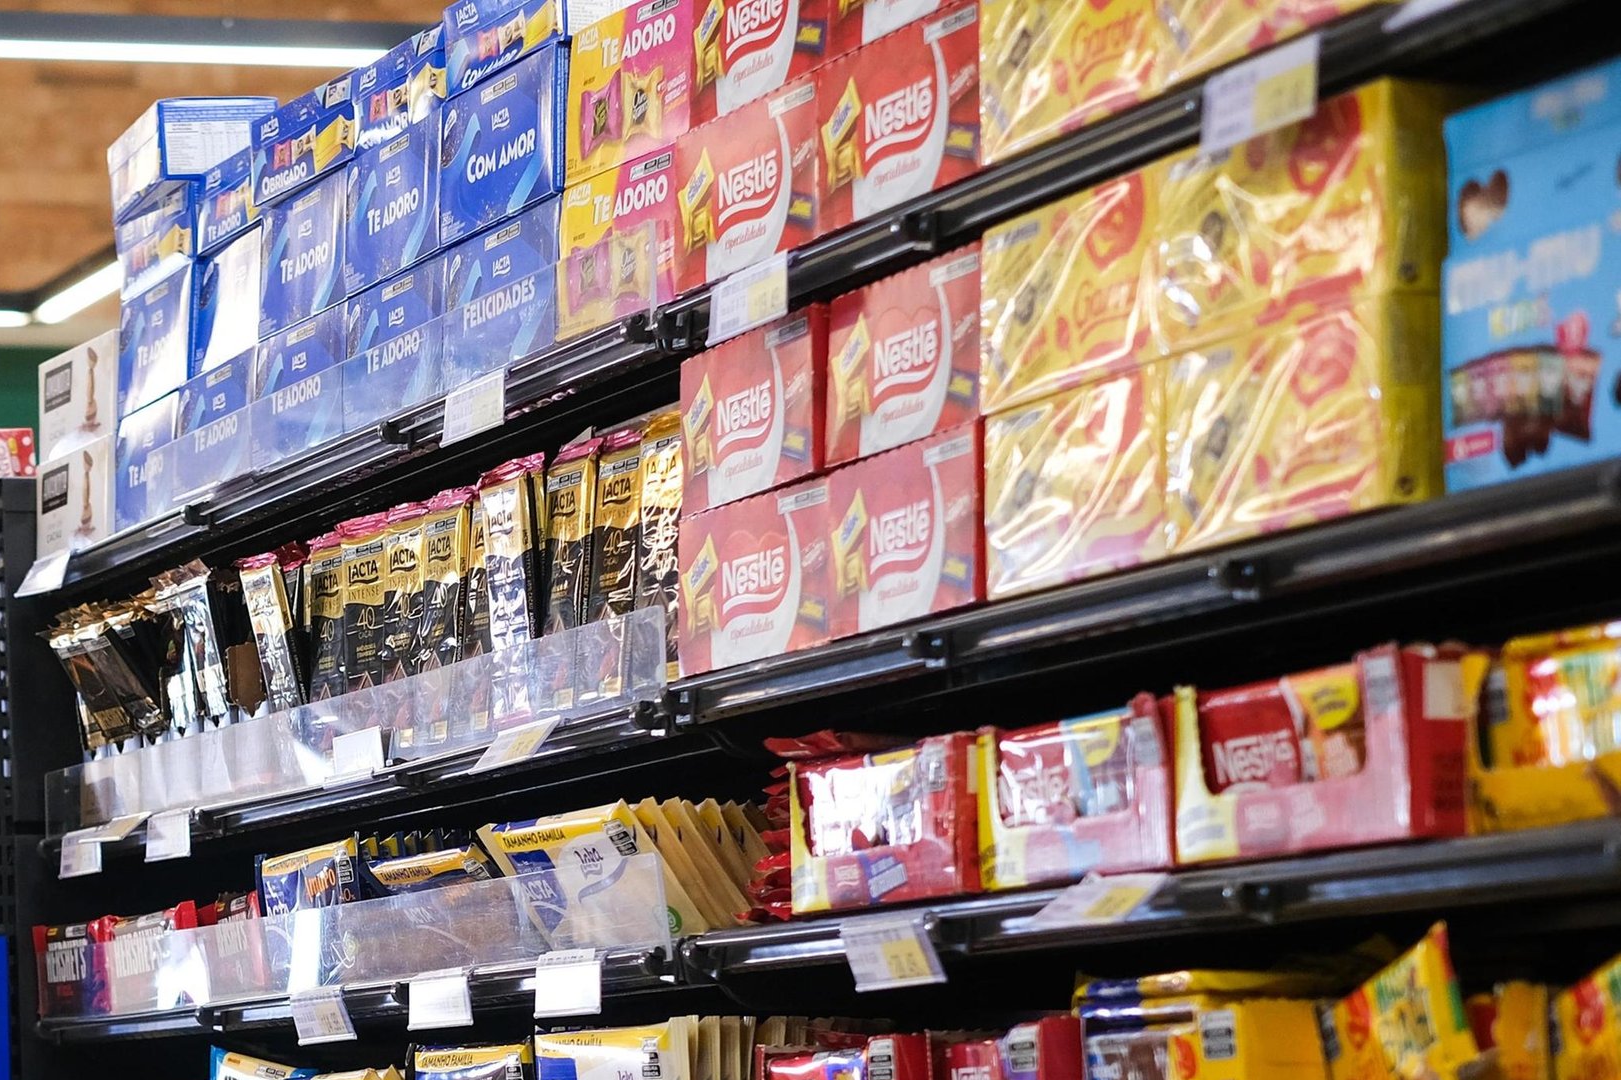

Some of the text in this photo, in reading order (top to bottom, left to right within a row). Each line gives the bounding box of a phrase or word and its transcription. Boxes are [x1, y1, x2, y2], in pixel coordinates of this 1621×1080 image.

[456, 2, 478, 27] LACTA
[578, 26, 598, 53] LACTA
[602, 14, 675, 68] TE ADORO
[360, 67, 376, 91] LACTA
[492, 107, 510, 131] LACTA
[865, 75, 932, 144] Nestlé
[261, 116, 279, 140] LACTA
[467, 129, 535, 184] COM AMOR
[262, 161, 307, 195] OBRIGADO
[386, 166, 400, 186] LACTA
[718, 149, 777, 209] Nestlé
[567, 183, 591, 208] LACTA
[593, 174, 668, 225] TE ADORO
[368, 208, 381, 235] TE
[382, 188, 418, 227] ADORO
[209, 212, 240, 243] TE ADORO
[281, 241, 328, 283] TE ADORO
[492, 255, 510, 277] LACTA
[463, 276, 535, 331] FELICIDADES
[388, 307, 404, 327] LACTA
[138, 347, 147, 367] TE
[292, 352, 307, 370] LACTA
[367, 331, 420, 374] TE ADORO
[874, 319, 938, 379] Nestlé
[272, 376, 321, 414] TE ADORO
[717, 378, 771, 436] Nestlé
[194, 416, 238, 453] TE ADORO
[129, 465, 139, 488] TE
[551, 491, 576, 518] LACTA
[603, 477, 631, 506] LACTA
[870, 502, 929, 557] Nestlé
[429, 535, 451, 563] LACTA
[603, 531, 622, 557] 40
[348, 560, 378, 586] LACTA
[390, 548, 416, 572] LACTA
[722, 546, 784, 598] Nestlé
[315, 572, 338, 598] LACTA
[349, 585, 380, 600] INTENSE
[431, 585, 448, 608] 40
[357, 606, 375, 629] 40
[395, 594, 409, 617] 40
[1213, 729, 1296, 785] Nestlé
[503, 829, 565, 848] TAMANHO FAMÍLIA
[380, 865, 432, 883] TAMANHO FAMÍLIA
[521, 880, 557, 901] ACTA
[422, 1054, 473, 1068] TAMANHO FAMÍLIA
